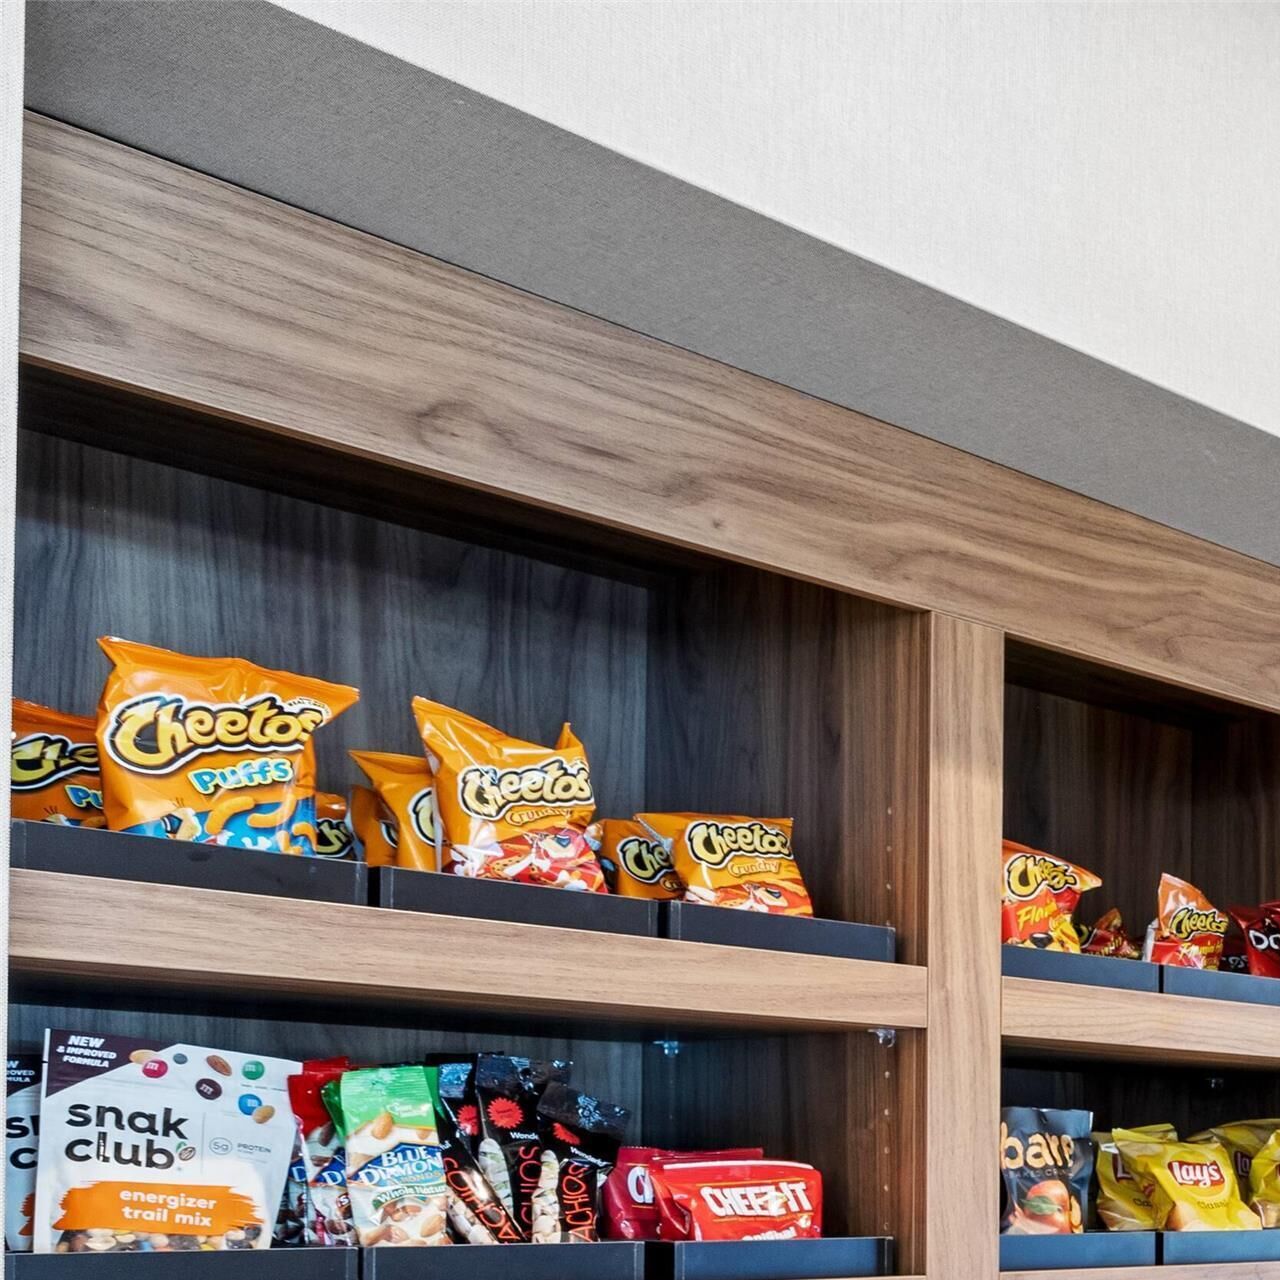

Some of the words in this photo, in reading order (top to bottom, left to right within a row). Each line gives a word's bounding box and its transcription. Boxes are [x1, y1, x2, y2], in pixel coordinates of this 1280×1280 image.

[113, 699, 325, 771] Cheetos
[190, 760, 293, 794] Puffs
[462, 758, 591, 819] Cheetos
[689, 822, 792, 869] Cheetos
[66, 1047, 117, 1060] IMPROVED
[67, 1033, 106, 1048] NEW
[63, 1054, 110, 1068] FORMULA
[65, 1103, 191, 1140] snak
[64, 1131, 176, 1171] club
[382, 1145, 429, 1168] BLUE
[1000, 1121, 1075, 1170] bare
[1174, 1161, 1225, 1187] Lay's
[119, 1188, 217, 1211] energizer
[123, 1206, 170, 1225] trail
[174, 1211, 213, 1228] mix
